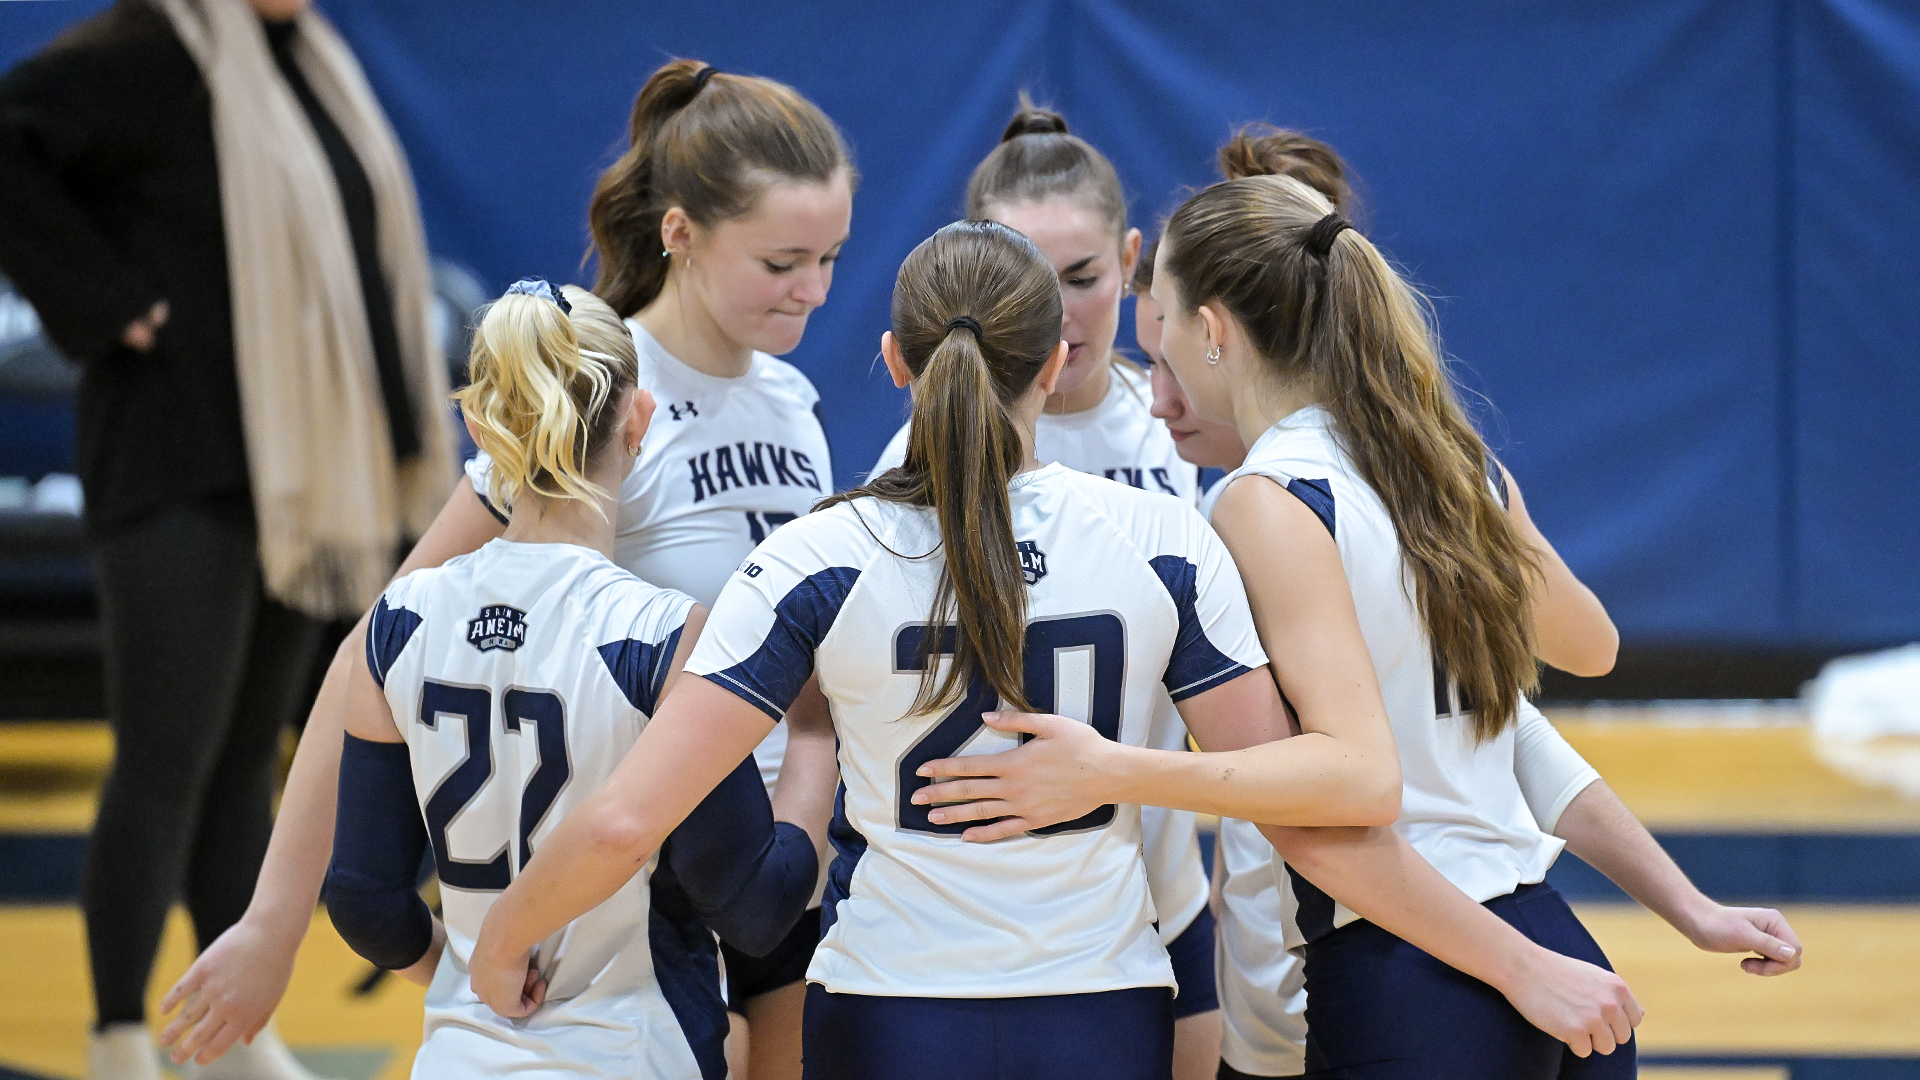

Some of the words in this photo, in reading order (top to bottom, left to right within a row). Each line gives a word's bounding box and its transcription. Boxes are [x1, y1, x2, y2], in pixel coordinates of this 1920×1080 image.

[688, 441, 822, 504] HAWKS
[416, 676, 574, 893] 22
[891, 609, 1128, 840] 20
